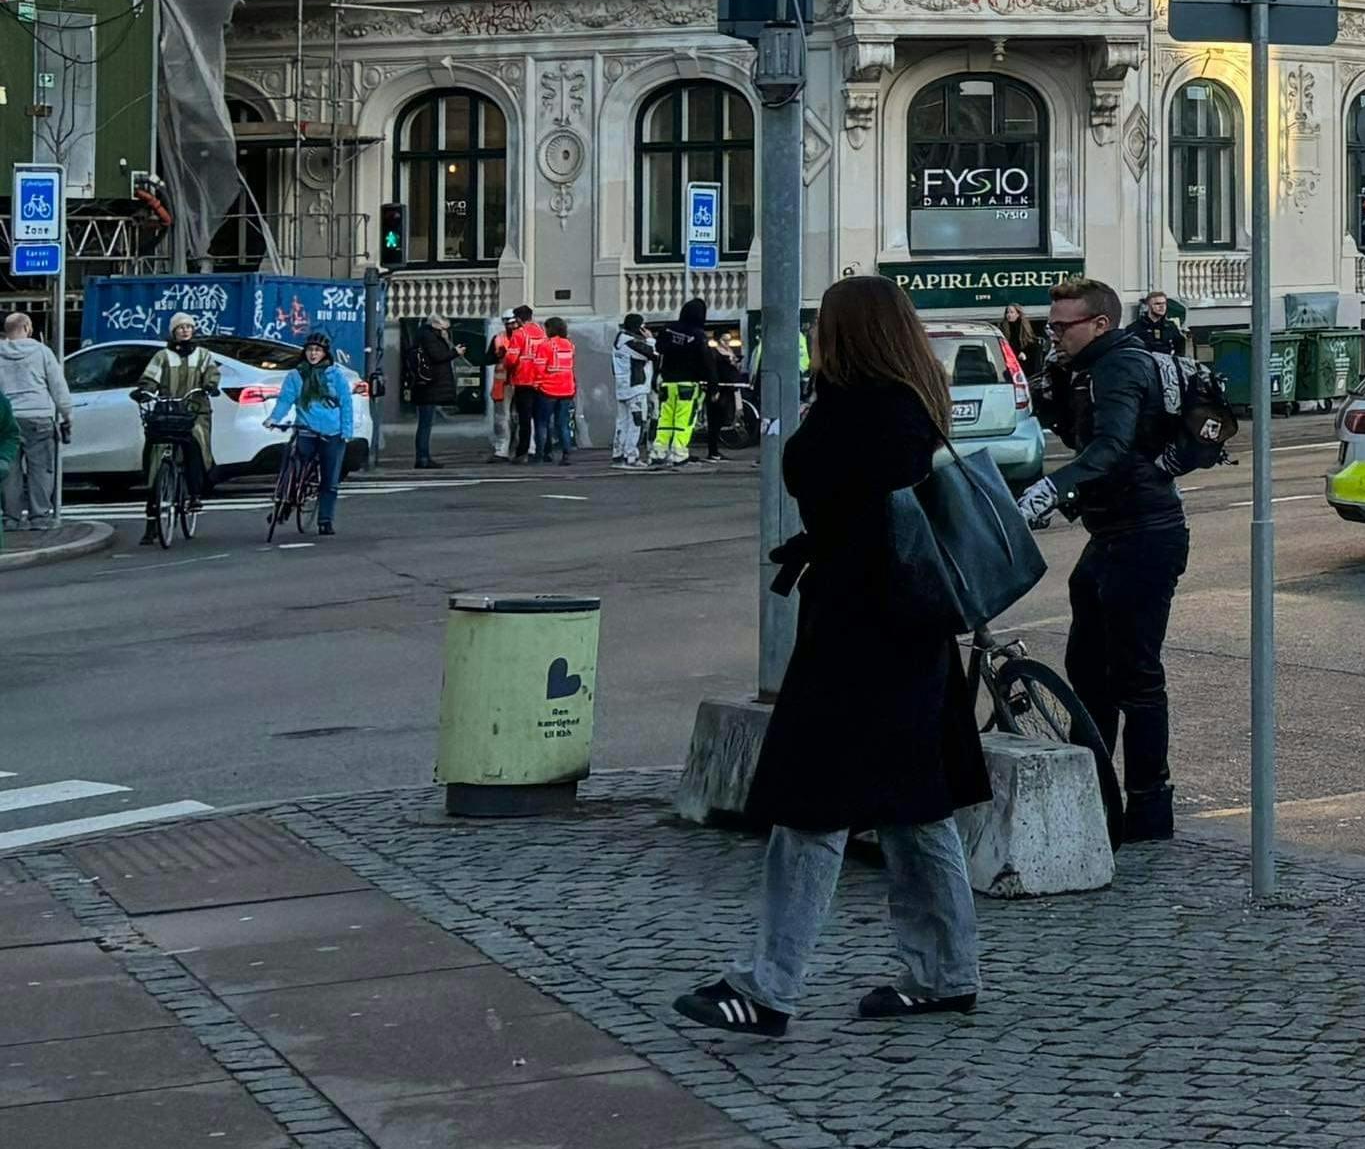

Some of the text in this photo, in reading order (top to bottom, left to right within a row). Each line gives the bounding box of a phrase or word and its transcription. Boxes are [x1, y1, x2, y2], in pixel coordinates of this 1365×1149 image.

[924, 168, 1029, 196] FYSIO
[924, 196, 1029, 207] DANMARK
[996, 210, 1029, 220] FYSIO
[896, 271, 1069, 290] PAPIRLAGERET
